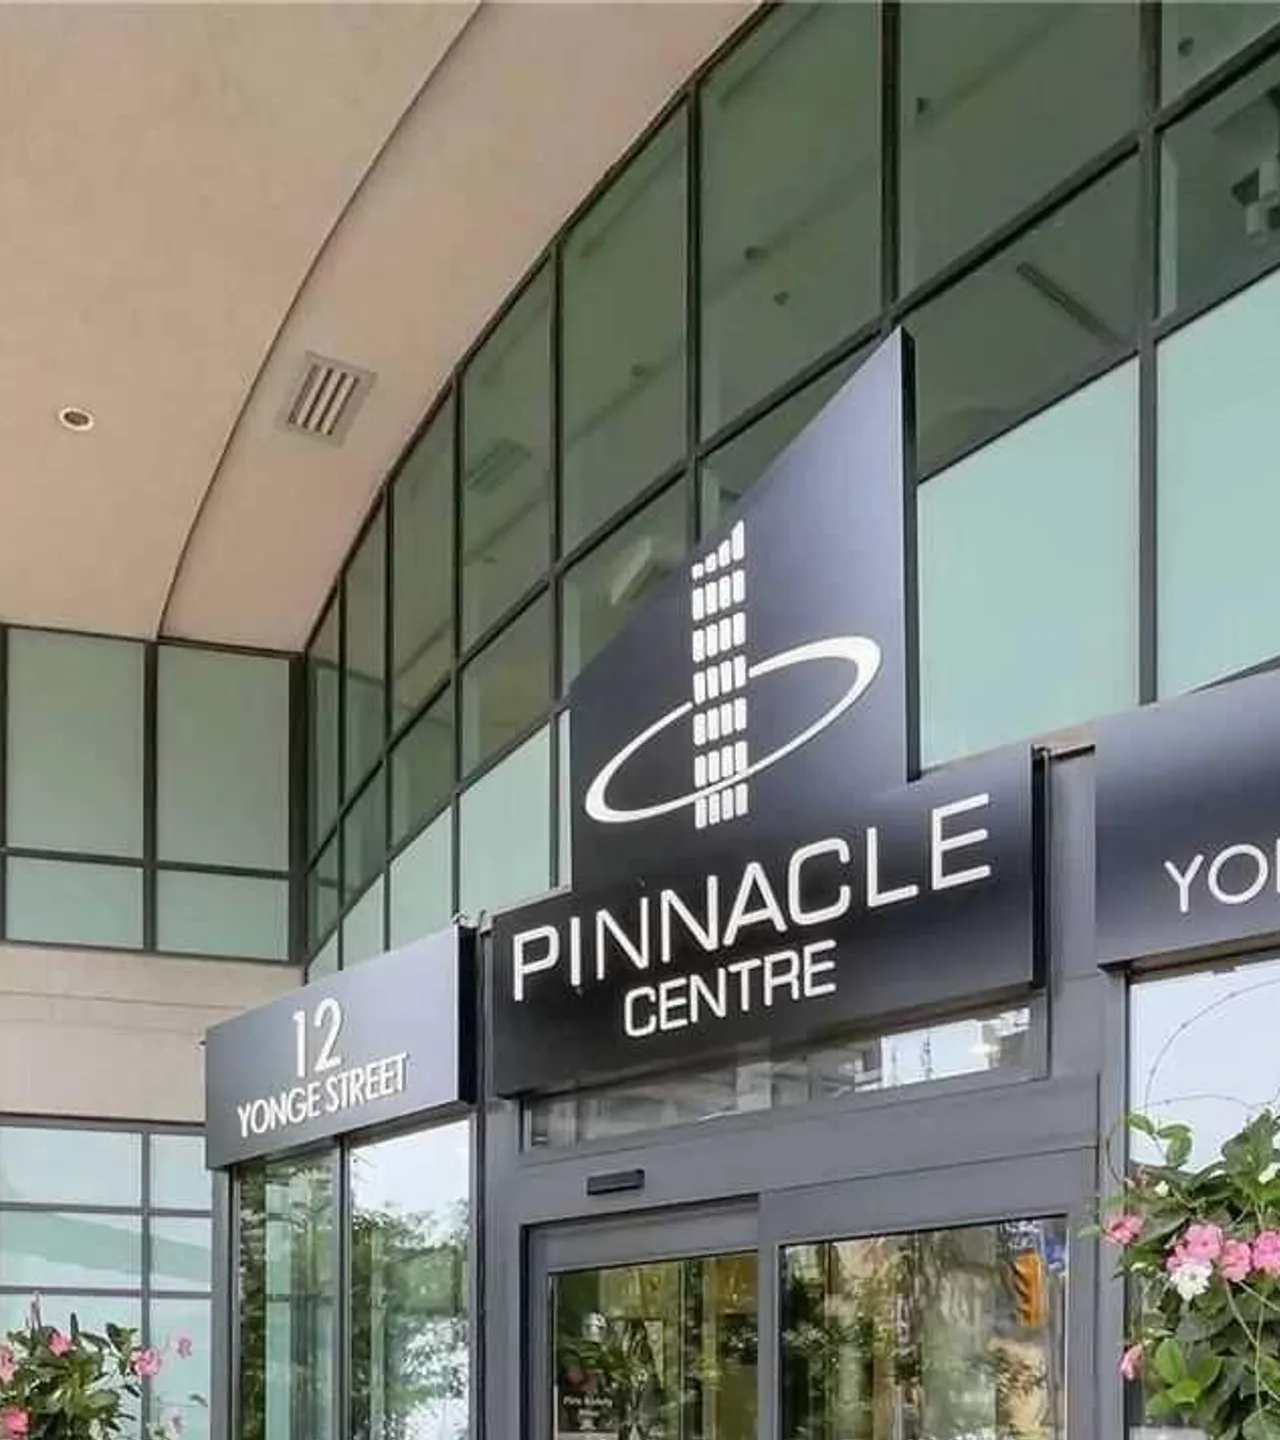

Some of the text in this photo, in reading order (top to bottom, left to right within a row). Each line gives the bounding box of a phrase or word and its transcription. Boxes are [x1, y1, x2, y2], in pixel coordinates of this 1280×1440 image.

[513, 792, 992, 1002] PINNACLE
[623, 938, 838, 1038] CENTRE
[292, 997, 343, 1079] 12
[236, 1051, 408, 1139] YONGE STREET
